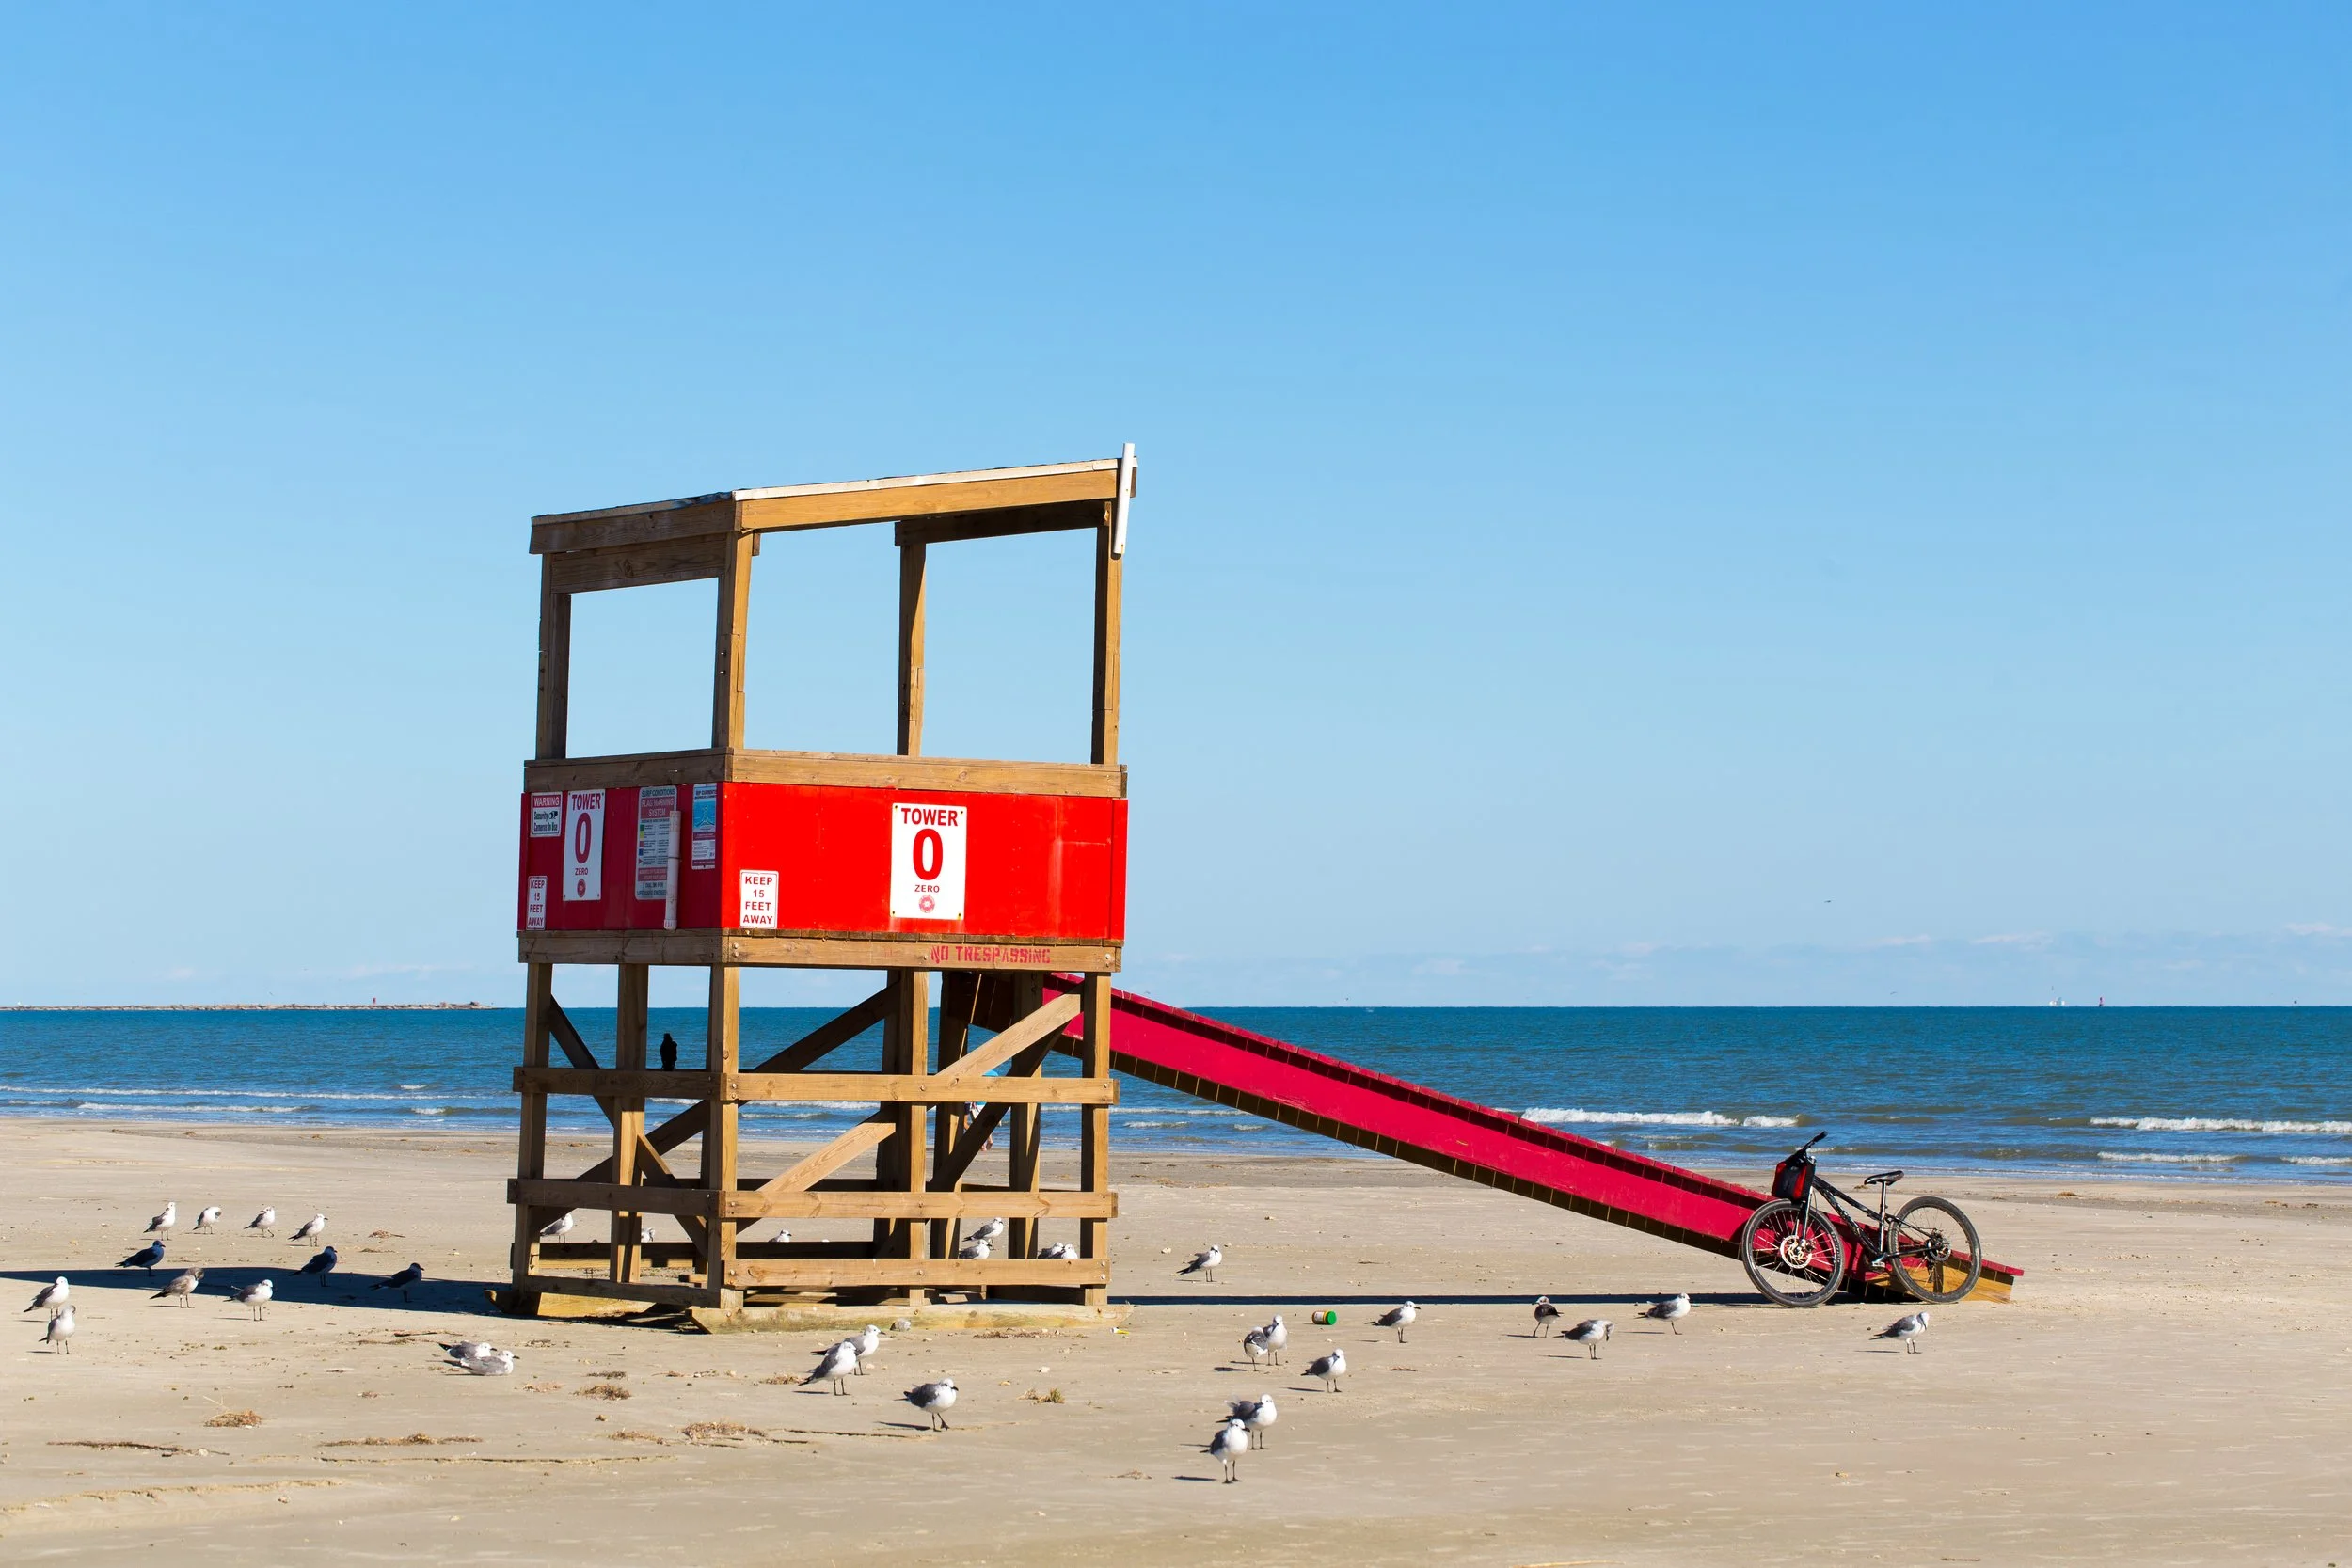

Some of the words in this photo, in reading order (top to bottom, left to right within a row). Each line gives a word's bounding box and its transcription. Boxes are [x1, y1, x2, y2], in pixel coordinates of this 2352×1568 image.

[533, 796, 560, 807] WARNING
[572, 793, 601, 810] TOWER
[534, 811, 548, 822] Security
[648, 807, 666, 816] SYSTEM
[901, 807, 958, 827] TOWER
[575, 812, 592, 864] 0
[913, 828, 944, 880] 0
[575, 867, 589, 876] ZERO
[530, 879, 545, 889] KEEP
[745, 876, 773, 885] KEEP
[753, 889, 765, 898] 15
[914, 884, 940, 893] ZERO
[533, 892, 541, 901] 15
[529, 904, 543, 913] FEET
[745, 901, 771, 911] FEET
[528, 917, 544, 927] AWAY
[742, 914, 773, 925] AWAY
[930, 945, 949, 964] NO
[955, 945, 1051, 964] TRESPASSING
